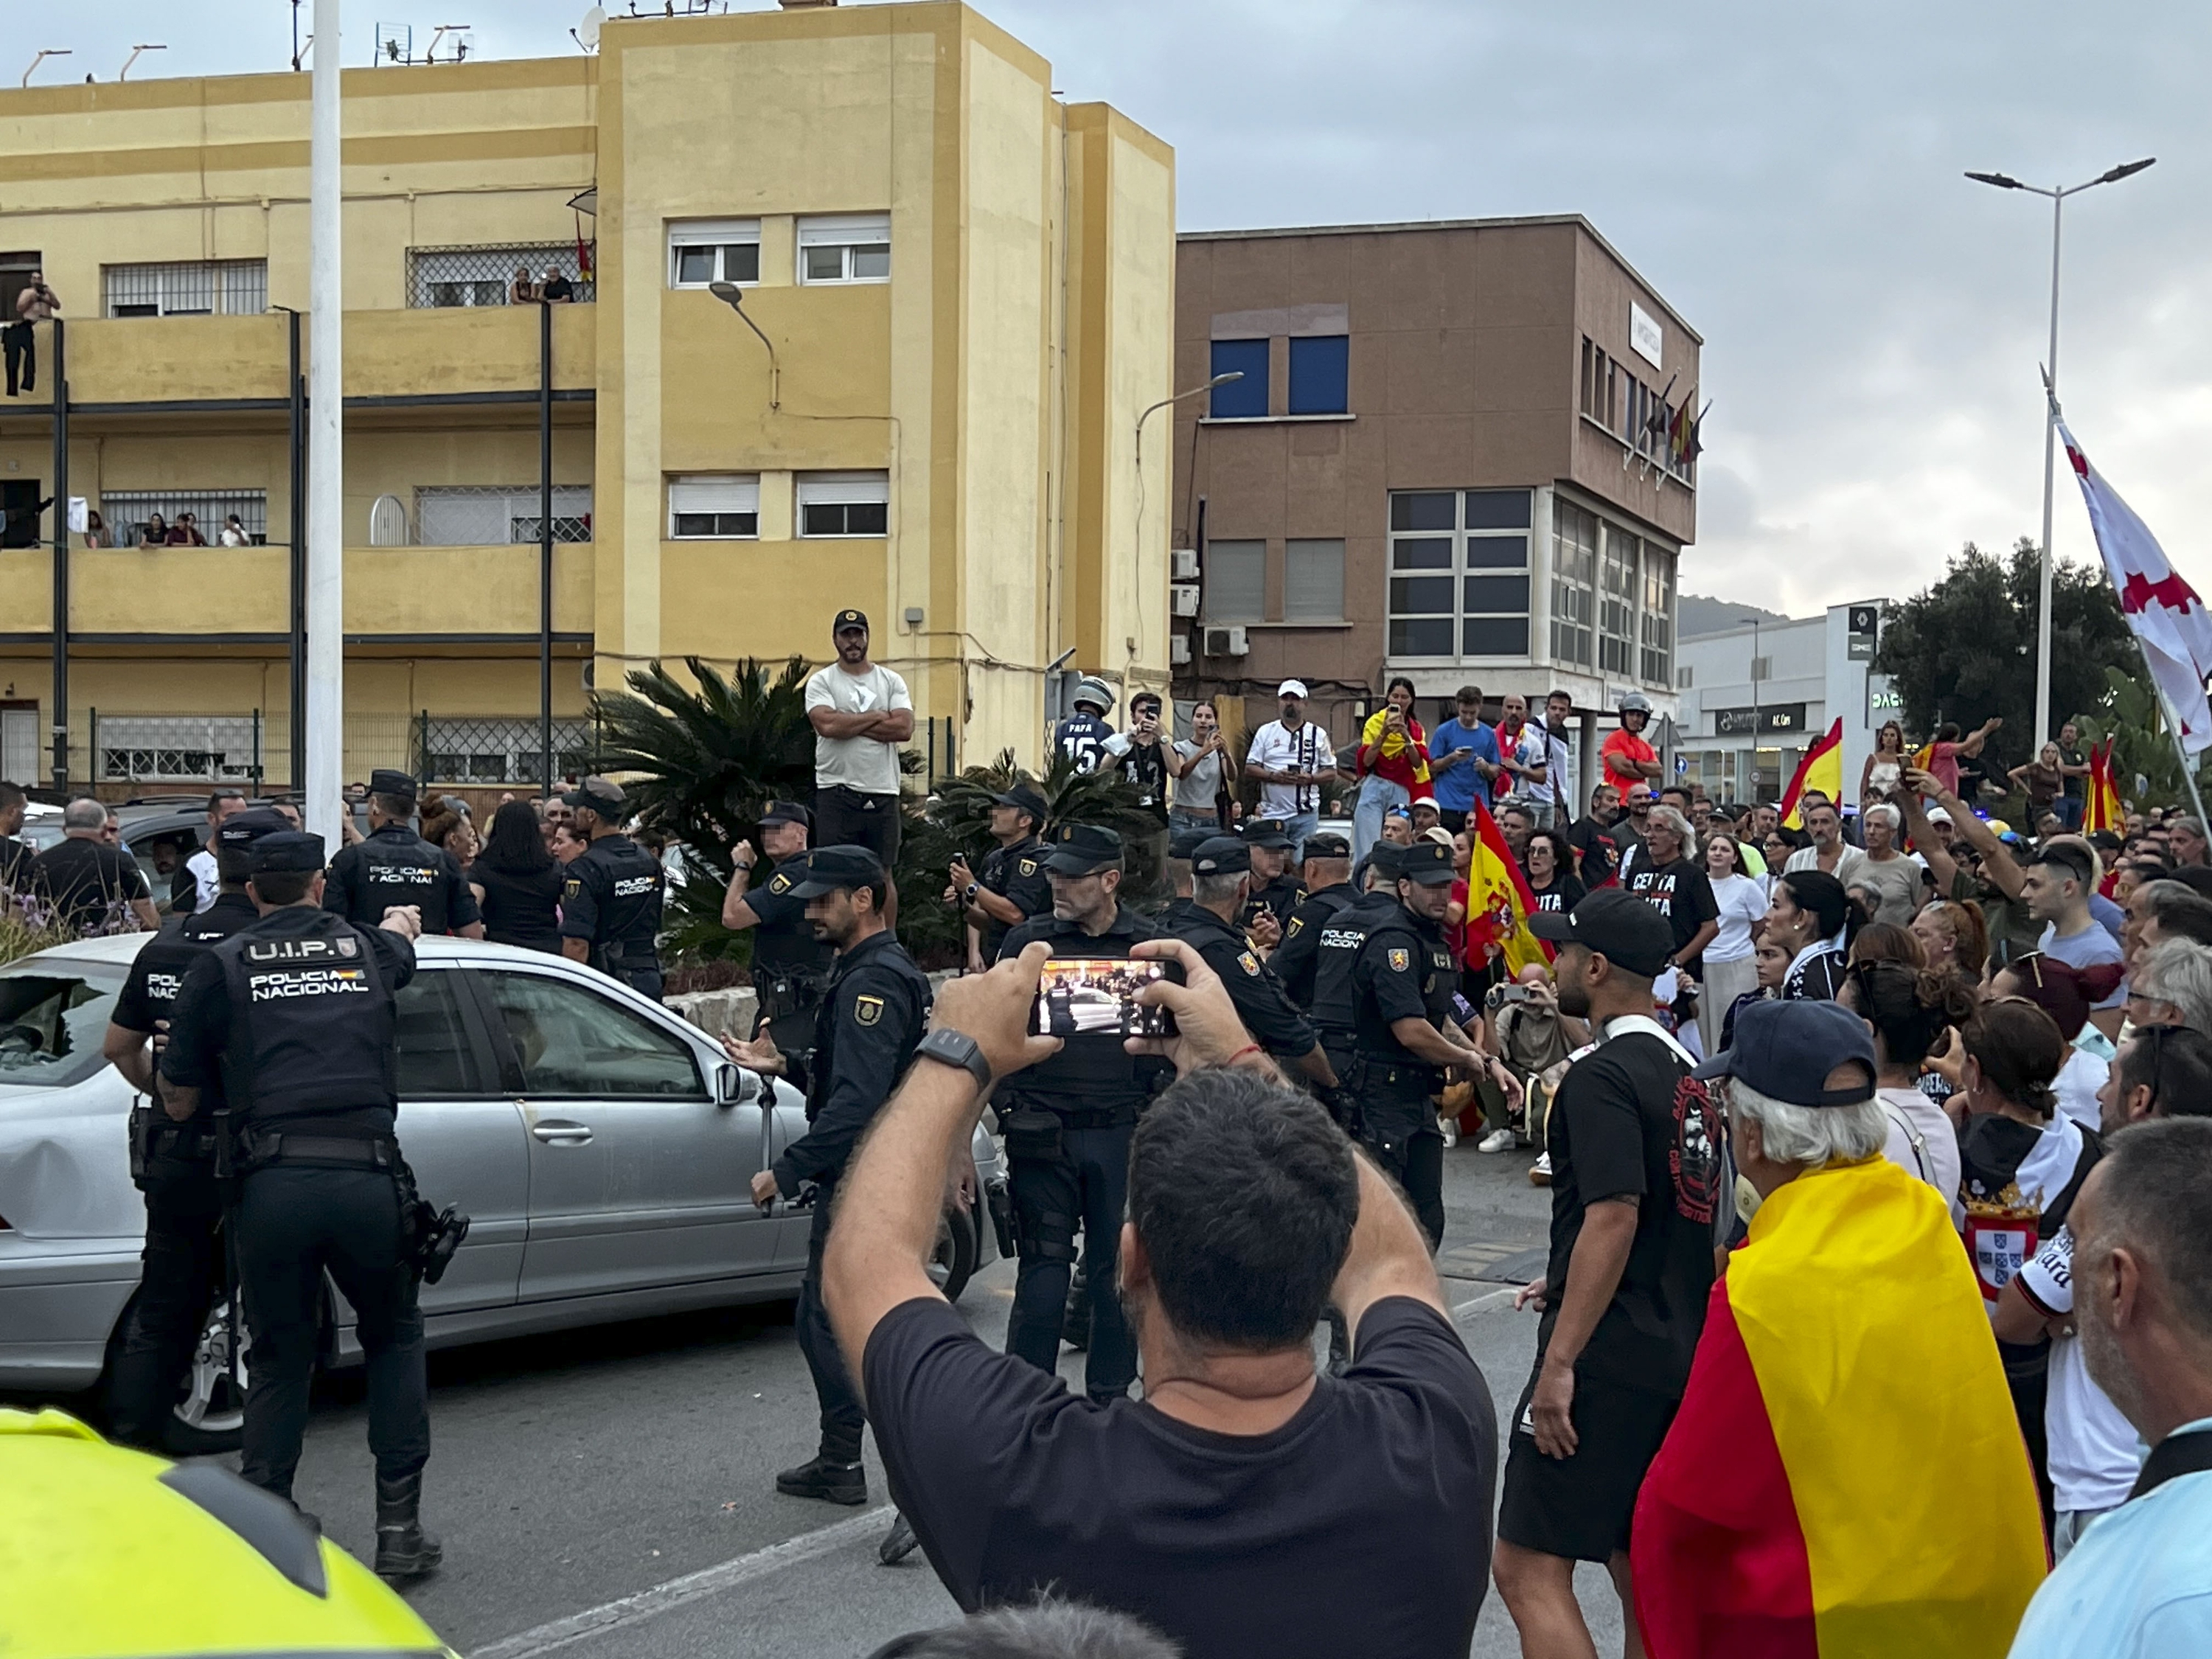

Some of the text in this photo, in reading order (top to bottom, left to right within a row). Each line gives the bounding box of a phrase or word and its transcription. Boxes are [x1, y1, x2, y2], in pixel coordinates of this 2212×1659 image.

[1063, 737, 1097, 775] 15
[615, 884, 659, 897] NACION
[1536, 894, 1562, 911] UTA
[1321, 930, 1366, 942] POLICIA
[249, 941, 335, 960] U.I.P.
[1320, 938, 1360, 950] NACION
[147, 974, 182, 987] POL
[250, 970, 342, 989] POLICIA
[148, 987, 179, 1000] NAC
[252, 981, 369, 1002] NACIONAL
